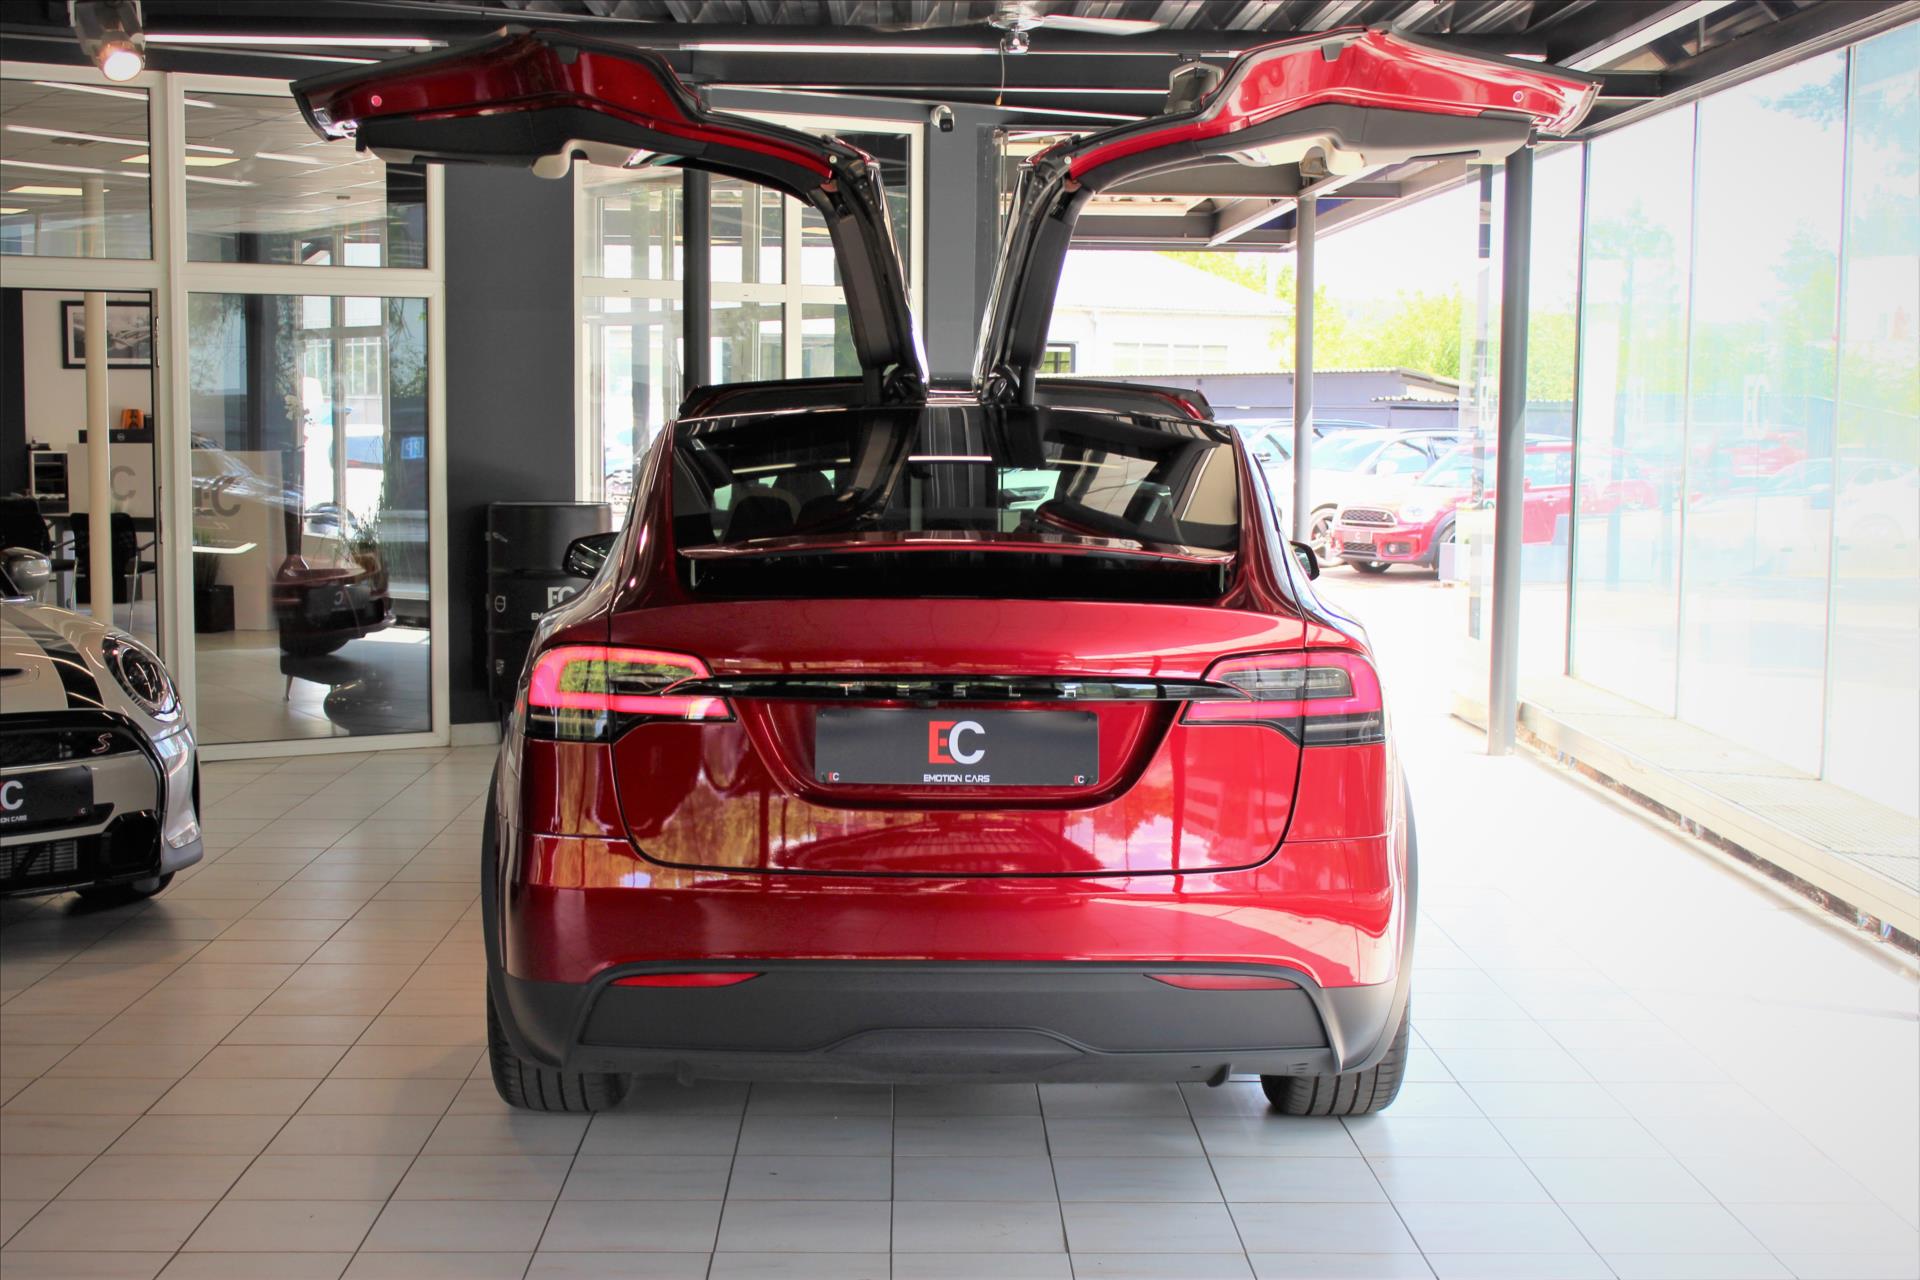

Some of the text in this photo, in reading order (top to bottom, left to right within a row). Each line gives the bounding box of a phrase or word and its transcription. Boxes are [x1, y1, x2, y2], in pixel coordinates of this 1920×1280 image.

[110, 466, 136, 501] C
[92, 733, 112, 753] S
[928, 720, 986, 765] EC
[923, 774, 962, 782] EMOTION
[0, 780, 24, 811] C
